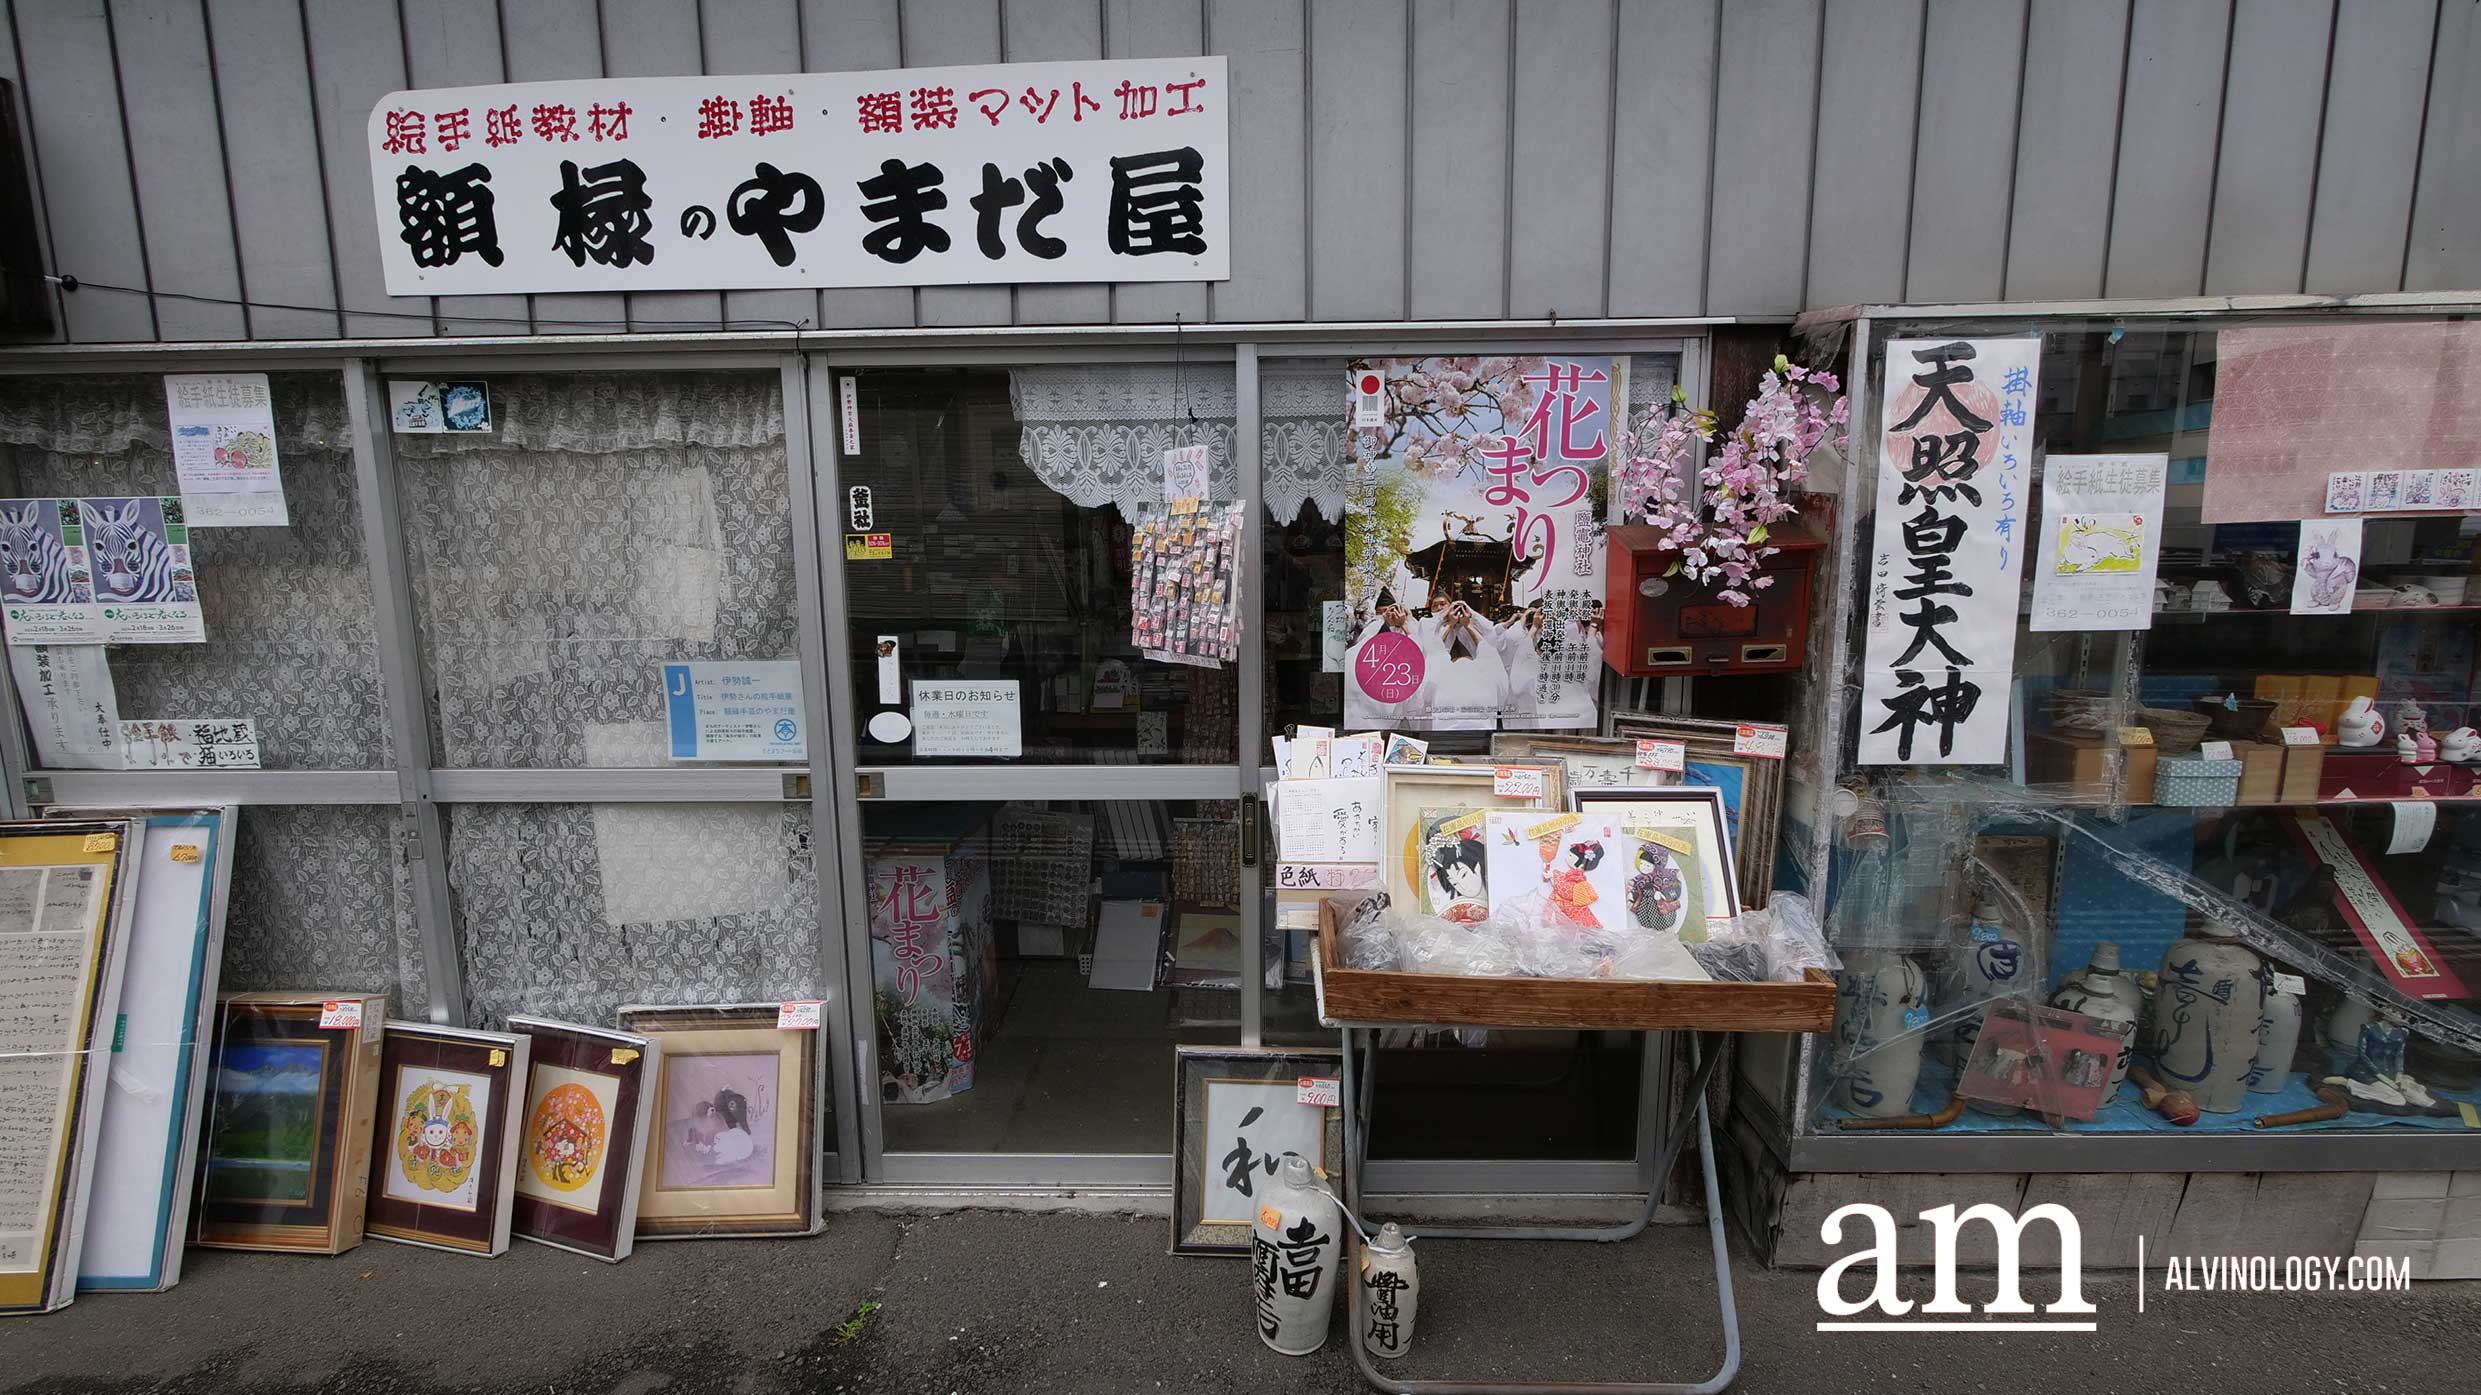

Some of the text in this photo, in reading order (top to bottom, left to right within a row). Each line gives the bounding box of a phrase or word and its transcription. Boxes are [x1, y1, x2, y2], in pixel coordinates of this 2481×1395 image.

[698, 94, 795, 139] 掛軸
[1481, 361, 1609, 594] 花まつり
[1993, 366, 2033, 573] 掛軸いろいろ有り
[2056, 467, 2162, 496] 絵手紙生徒募集
[1869, 341, 1995, 763] 天照皇大神
[919, 690, 1016, 701] 休業日のお知らせ
[1280, 865, 1321, 888] 色紙
[878, 864, 945, 1007] 花まつり
